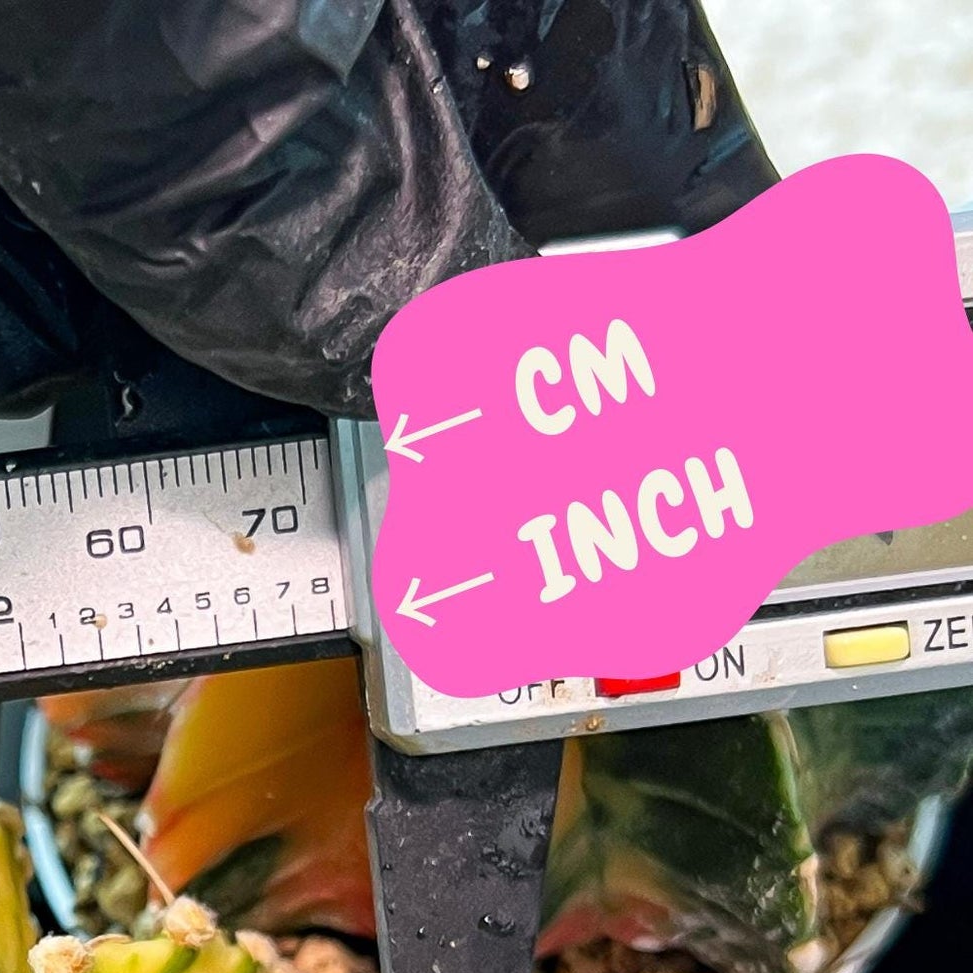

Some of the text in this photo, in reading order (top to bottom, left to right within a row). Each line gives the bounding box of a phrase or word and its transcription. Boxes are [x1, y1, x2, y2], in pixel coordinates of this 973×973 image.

[86, 525, 145, 559] 60
[241, 505, 299, 538] 70
[48, 611, 58, 630] 1
[79, 607, 99, 625] 2
[117, 602, 135, 619] 3
[156, 597, 173, 614] 4
[195, 591, 211, 610] 5
[234, 587, 251, 605] 6
[276, 581, 291, 599] 7
[311, 577, 330, 595] 8
[694, 645, 745, 681] ON
[923, 616, 973, 652] ZE
